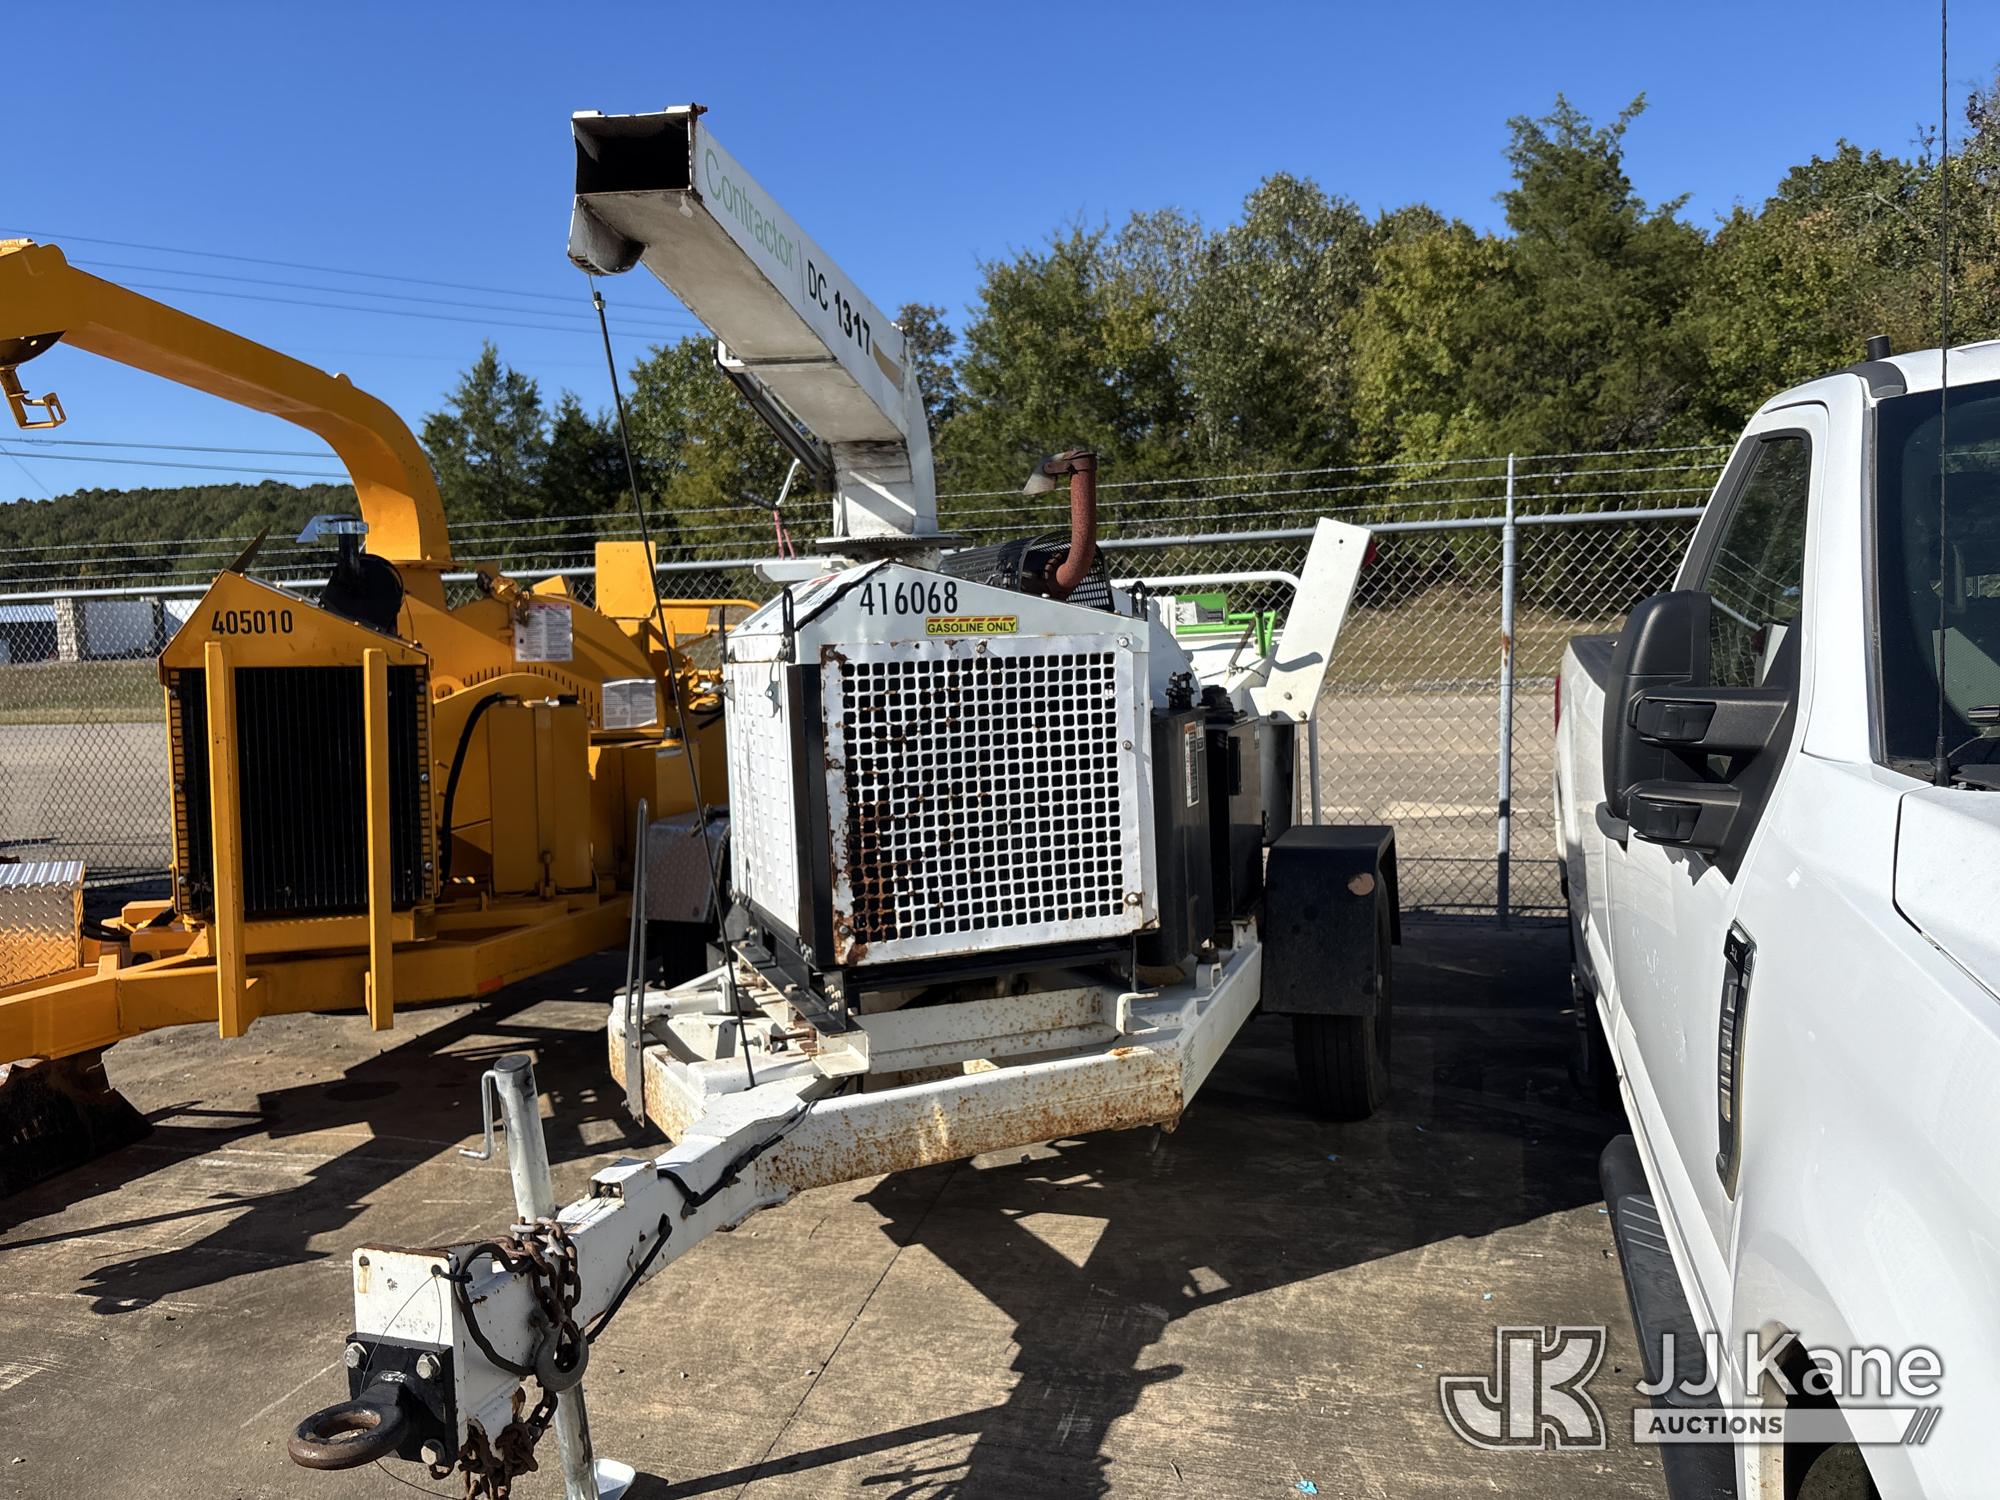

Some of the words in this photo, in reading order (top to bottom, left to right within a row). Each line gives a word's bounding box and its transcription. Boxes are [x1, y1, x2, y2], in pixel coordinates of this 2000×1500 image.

[705, 148, 793, 272] Contractor
[808, 259, 828, 311] DC
[834, 289, 870, 356] 1317
[860, 581, 958, 615] 416068
[211, 609, 293, 635] 405010
[927, 622, 984, 633] GASOLINE
[987, 621, 1016, 632] ONLY
